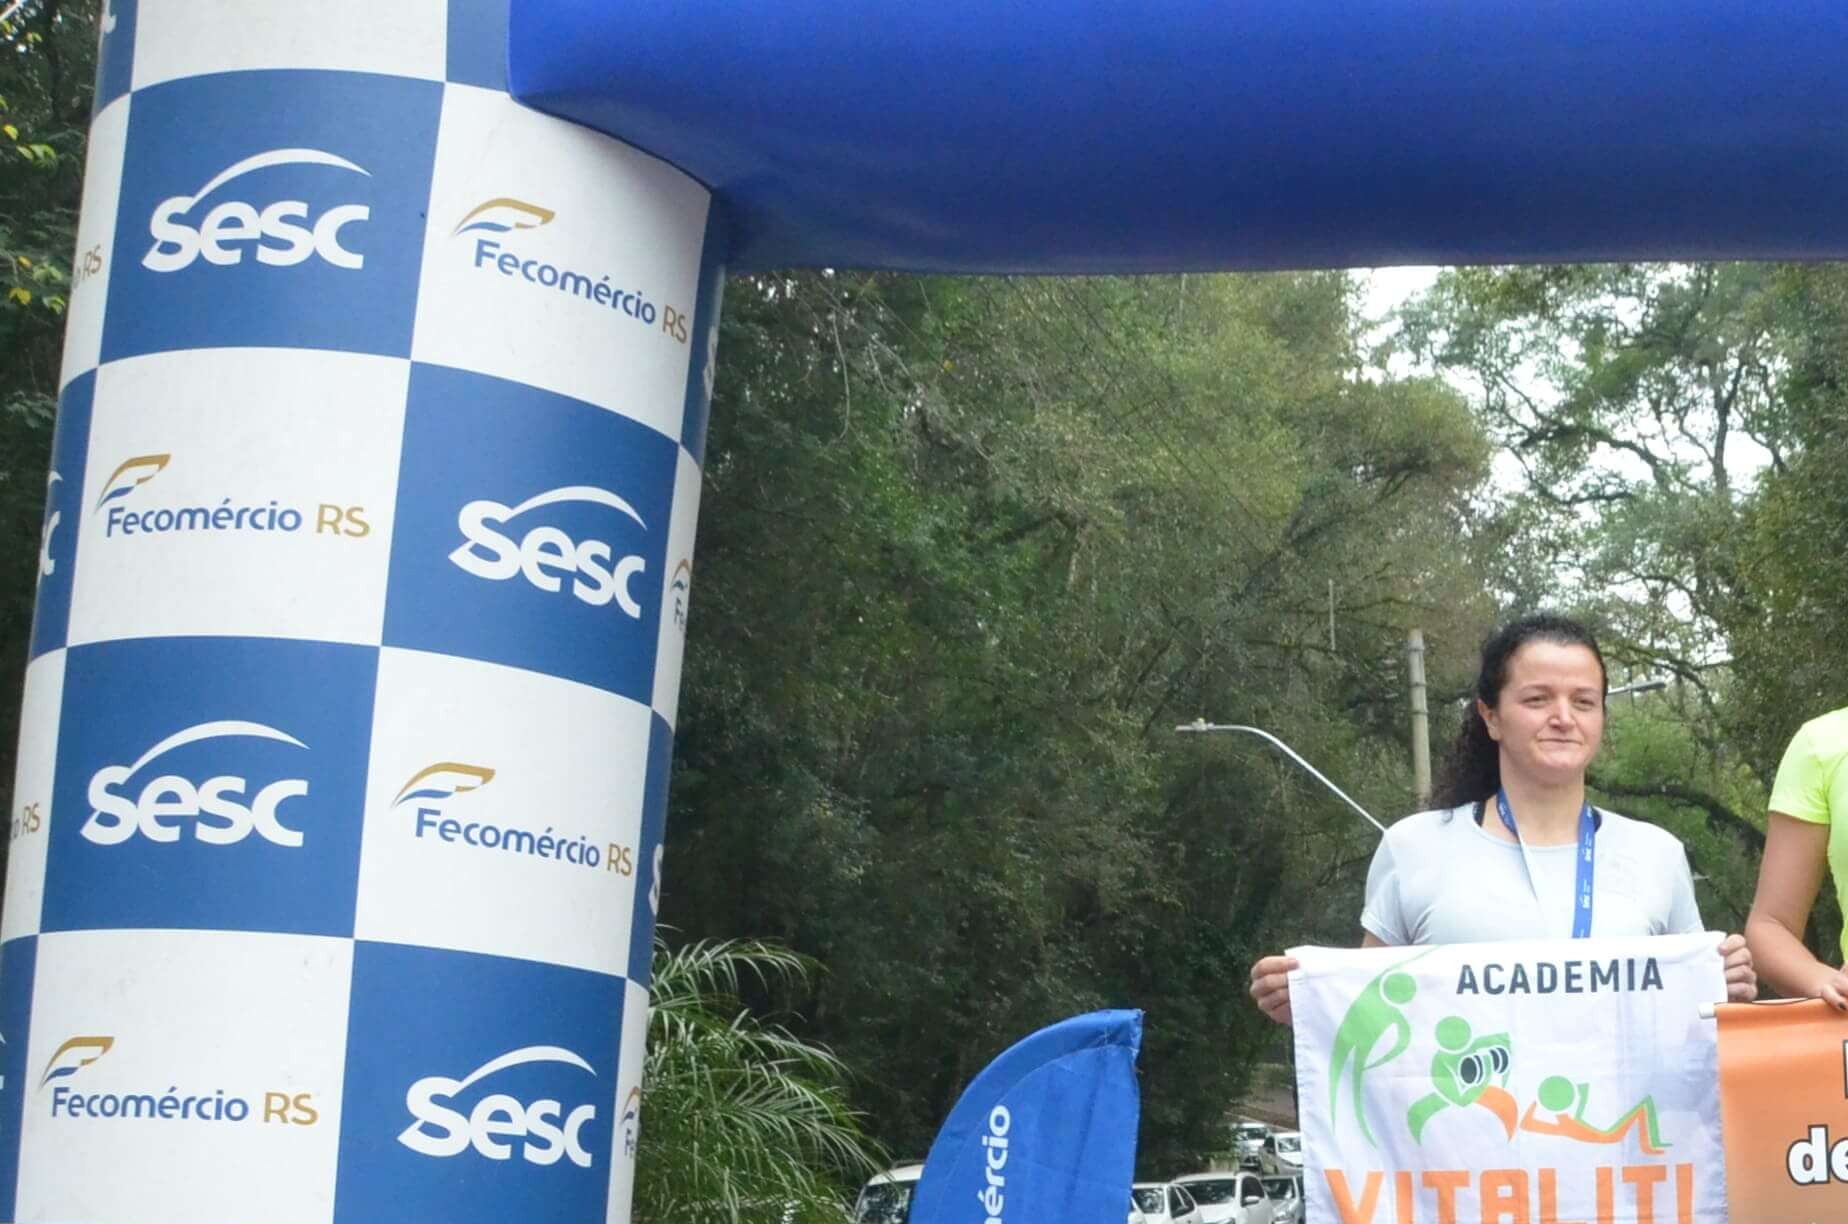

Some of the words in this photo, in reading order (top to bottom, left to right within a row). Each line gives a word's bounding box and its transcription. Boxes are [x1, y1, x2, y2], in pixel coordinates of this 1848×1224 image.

[474, 239, 657, 325] Fecomércio
[662, 304, 688, 345] RS
[106, 497, 302, 538] Fecomércio
[315, 504, 370, 538] RS
[414, 806, 600, 868] Fecomércio
[607, 839, 632, 877] RS
[1456, 957, 1664, 996] ACADEMIA
[51, 1086, 248, 1124] Fecomércio
[264, 1091, 318, 1127] RS
